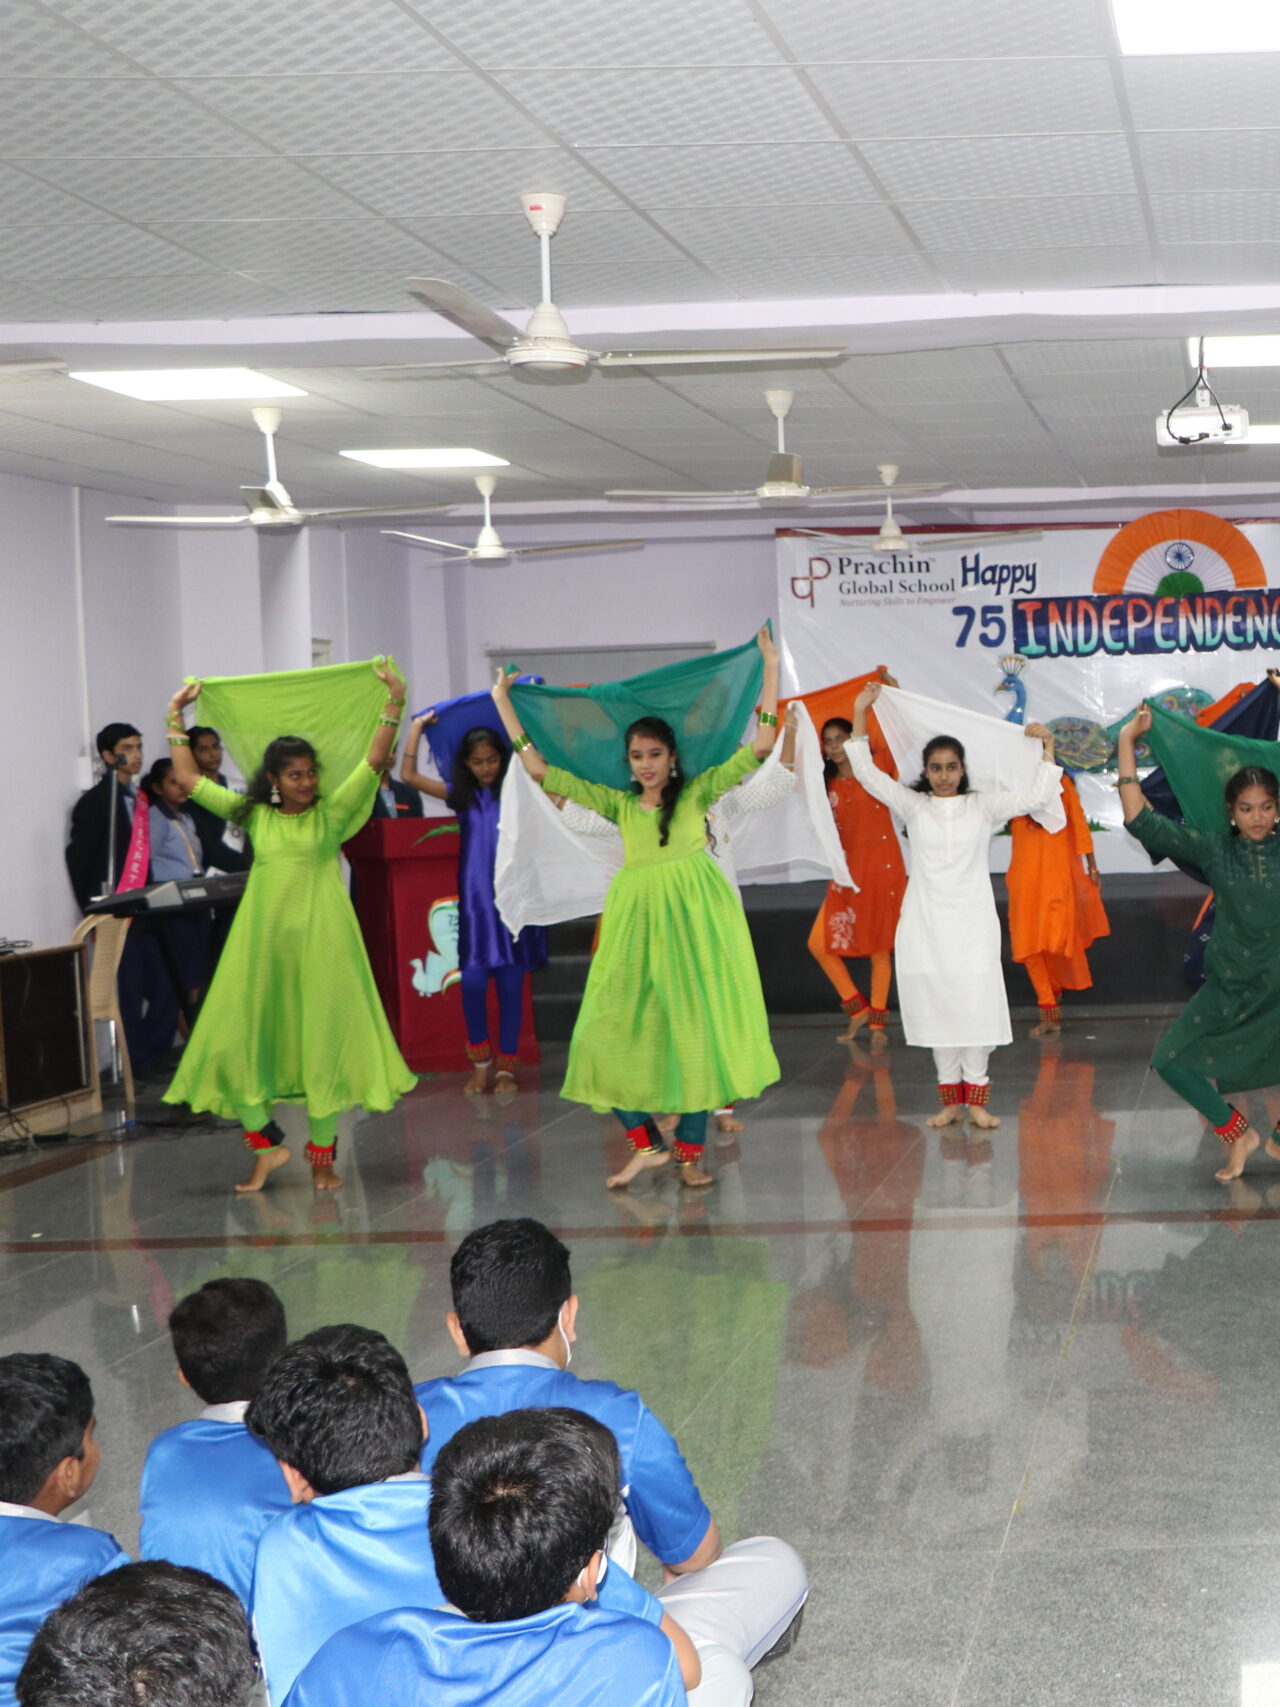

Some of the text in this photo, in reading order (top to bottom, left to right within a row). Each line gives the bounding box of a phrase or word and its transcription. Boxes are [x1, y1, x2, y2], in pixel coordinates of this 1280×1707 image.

[838, 554, 931, 575] Prachin
[961, 552, 1037, 596] Happy
[839, 578, 955, 595] Global School
[952, 605, 1007, 648] 75
